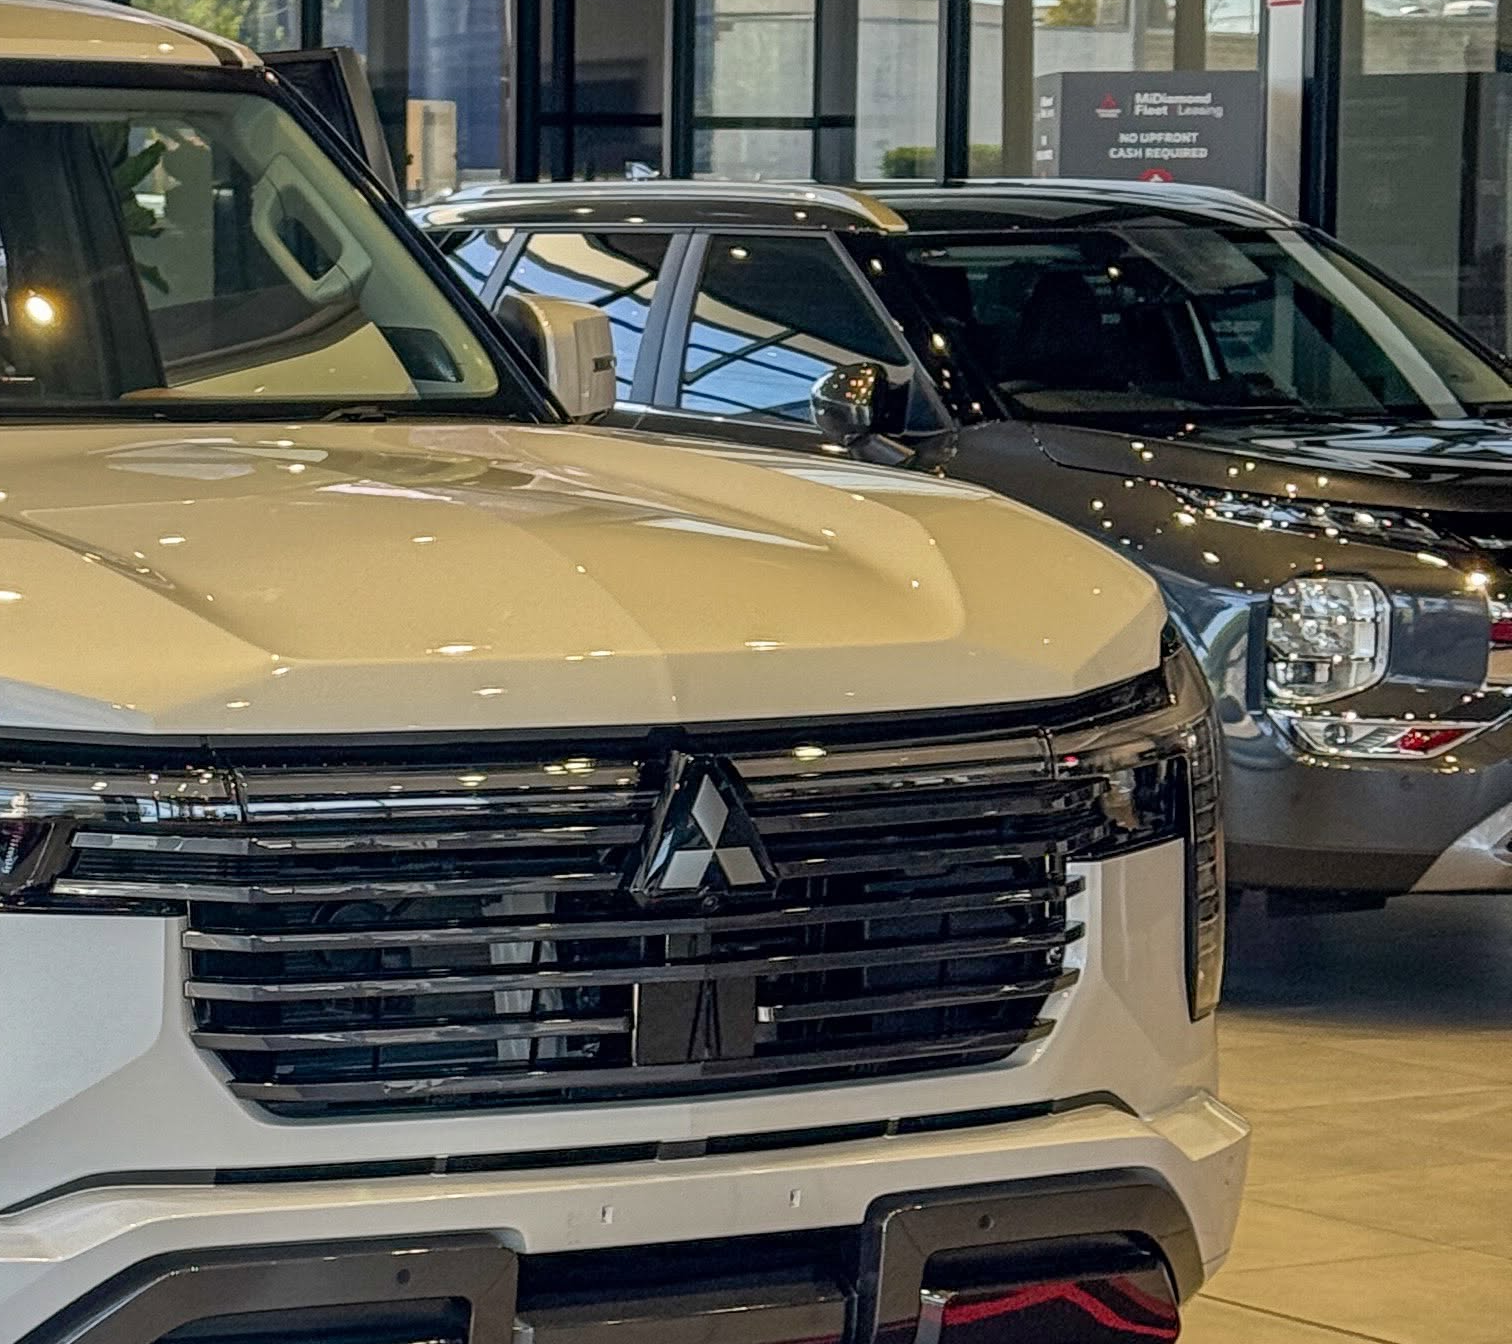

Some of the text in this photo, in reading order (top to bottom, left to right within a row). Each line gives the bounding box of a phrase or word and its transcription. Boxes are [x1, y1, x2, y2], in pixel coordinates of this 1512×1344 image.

[1119, 132, 1199, 144] NO UPFRONT
[1108, 147, 1209, 160] CASH REQUIRED
